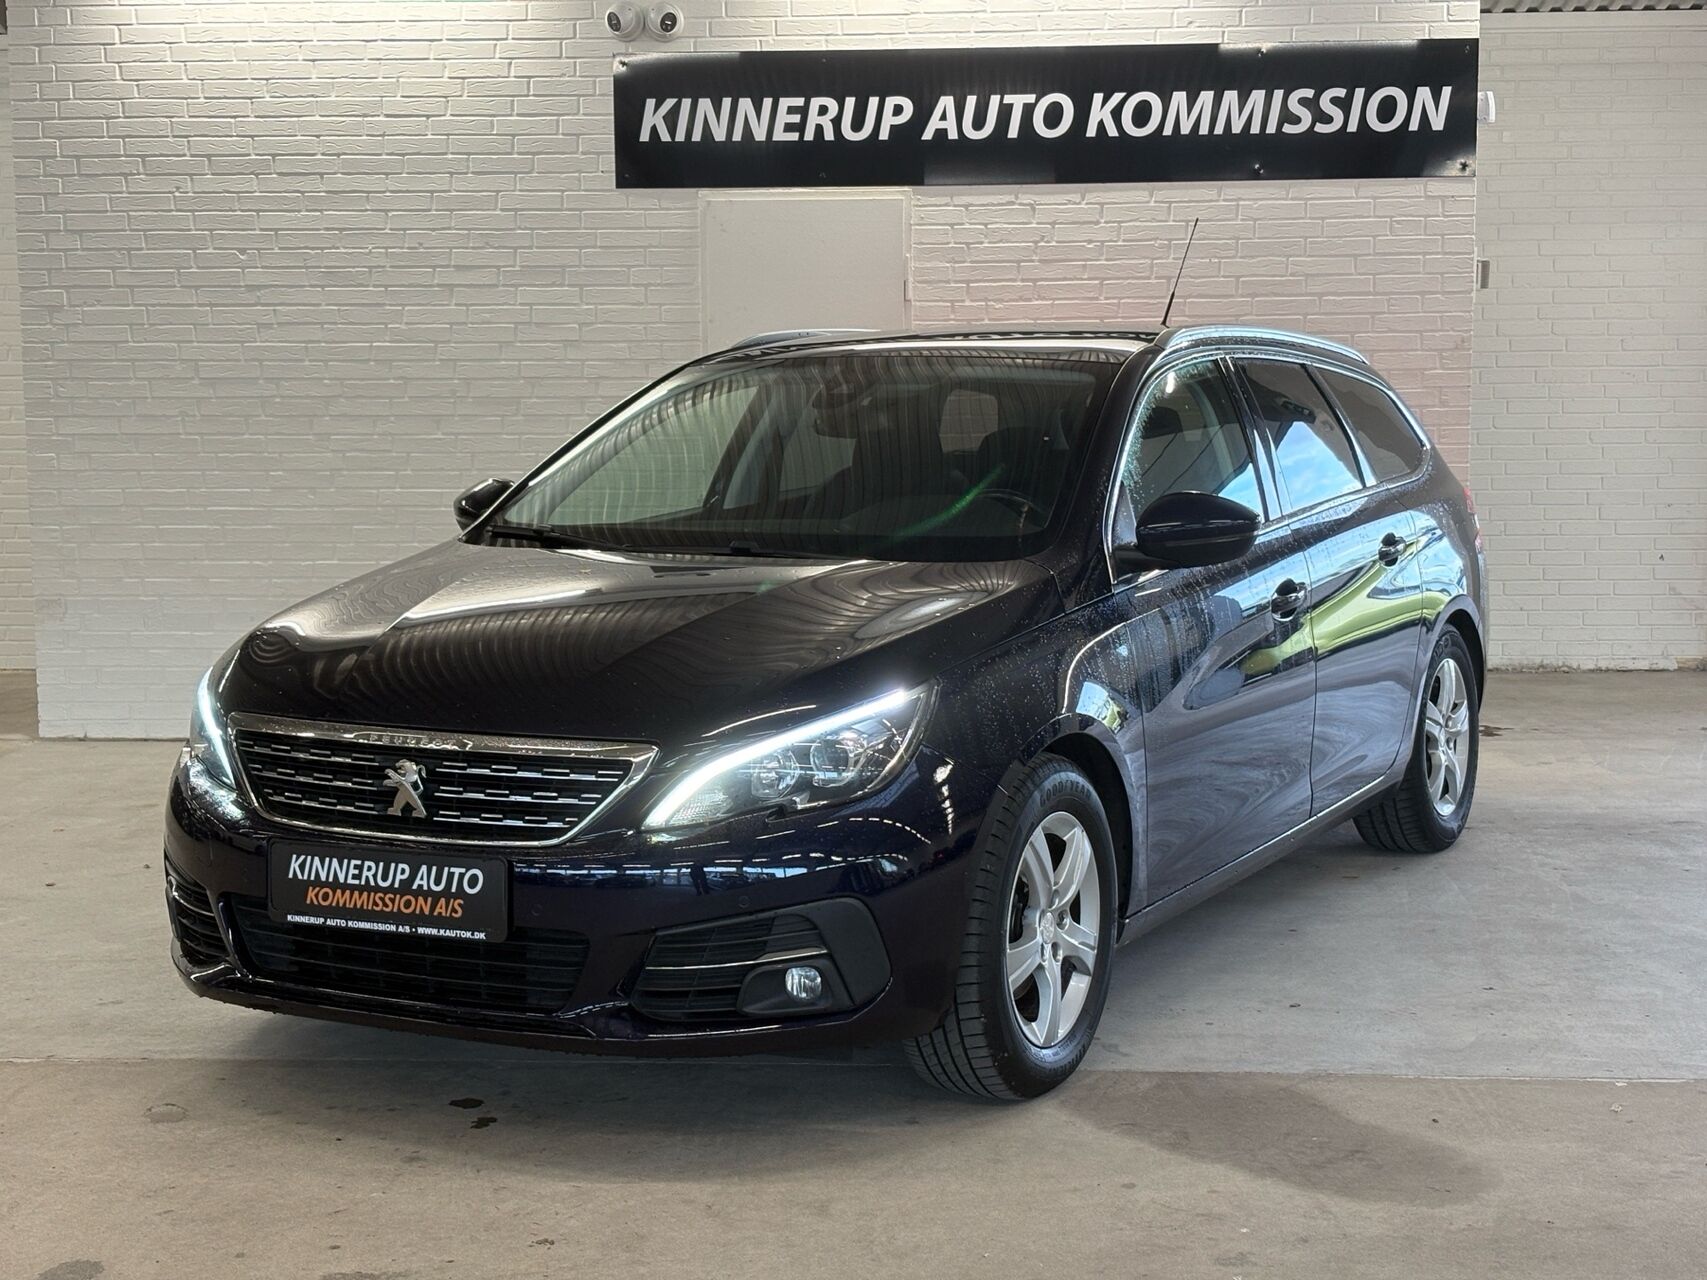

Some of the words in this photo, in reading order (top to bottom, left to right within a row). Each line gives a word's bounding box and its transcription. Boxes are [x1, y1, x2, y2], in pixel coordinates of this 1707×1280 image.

[639, 96, 914, 142] KINNERUP
[920, 93, 1075, 141] AUTO
[1085, 86, 1453, 138] KOMMISSION
[288, 854, 410, 889] KINNERUP
[411, 864, 484, 895] AUTO
[306, 886, 432, 915] KOMMISSION
[433, 897, 464, 918] A/S
[287, 914, 325, 925] KINNERUP
[326, 918, 347, 927] AUTO
[347, 920, 396, 932] KOMMISSION
[397, 925, 411, 933] A/S
[417, 926, 486, 940] WWW.KAUTOK.DK
